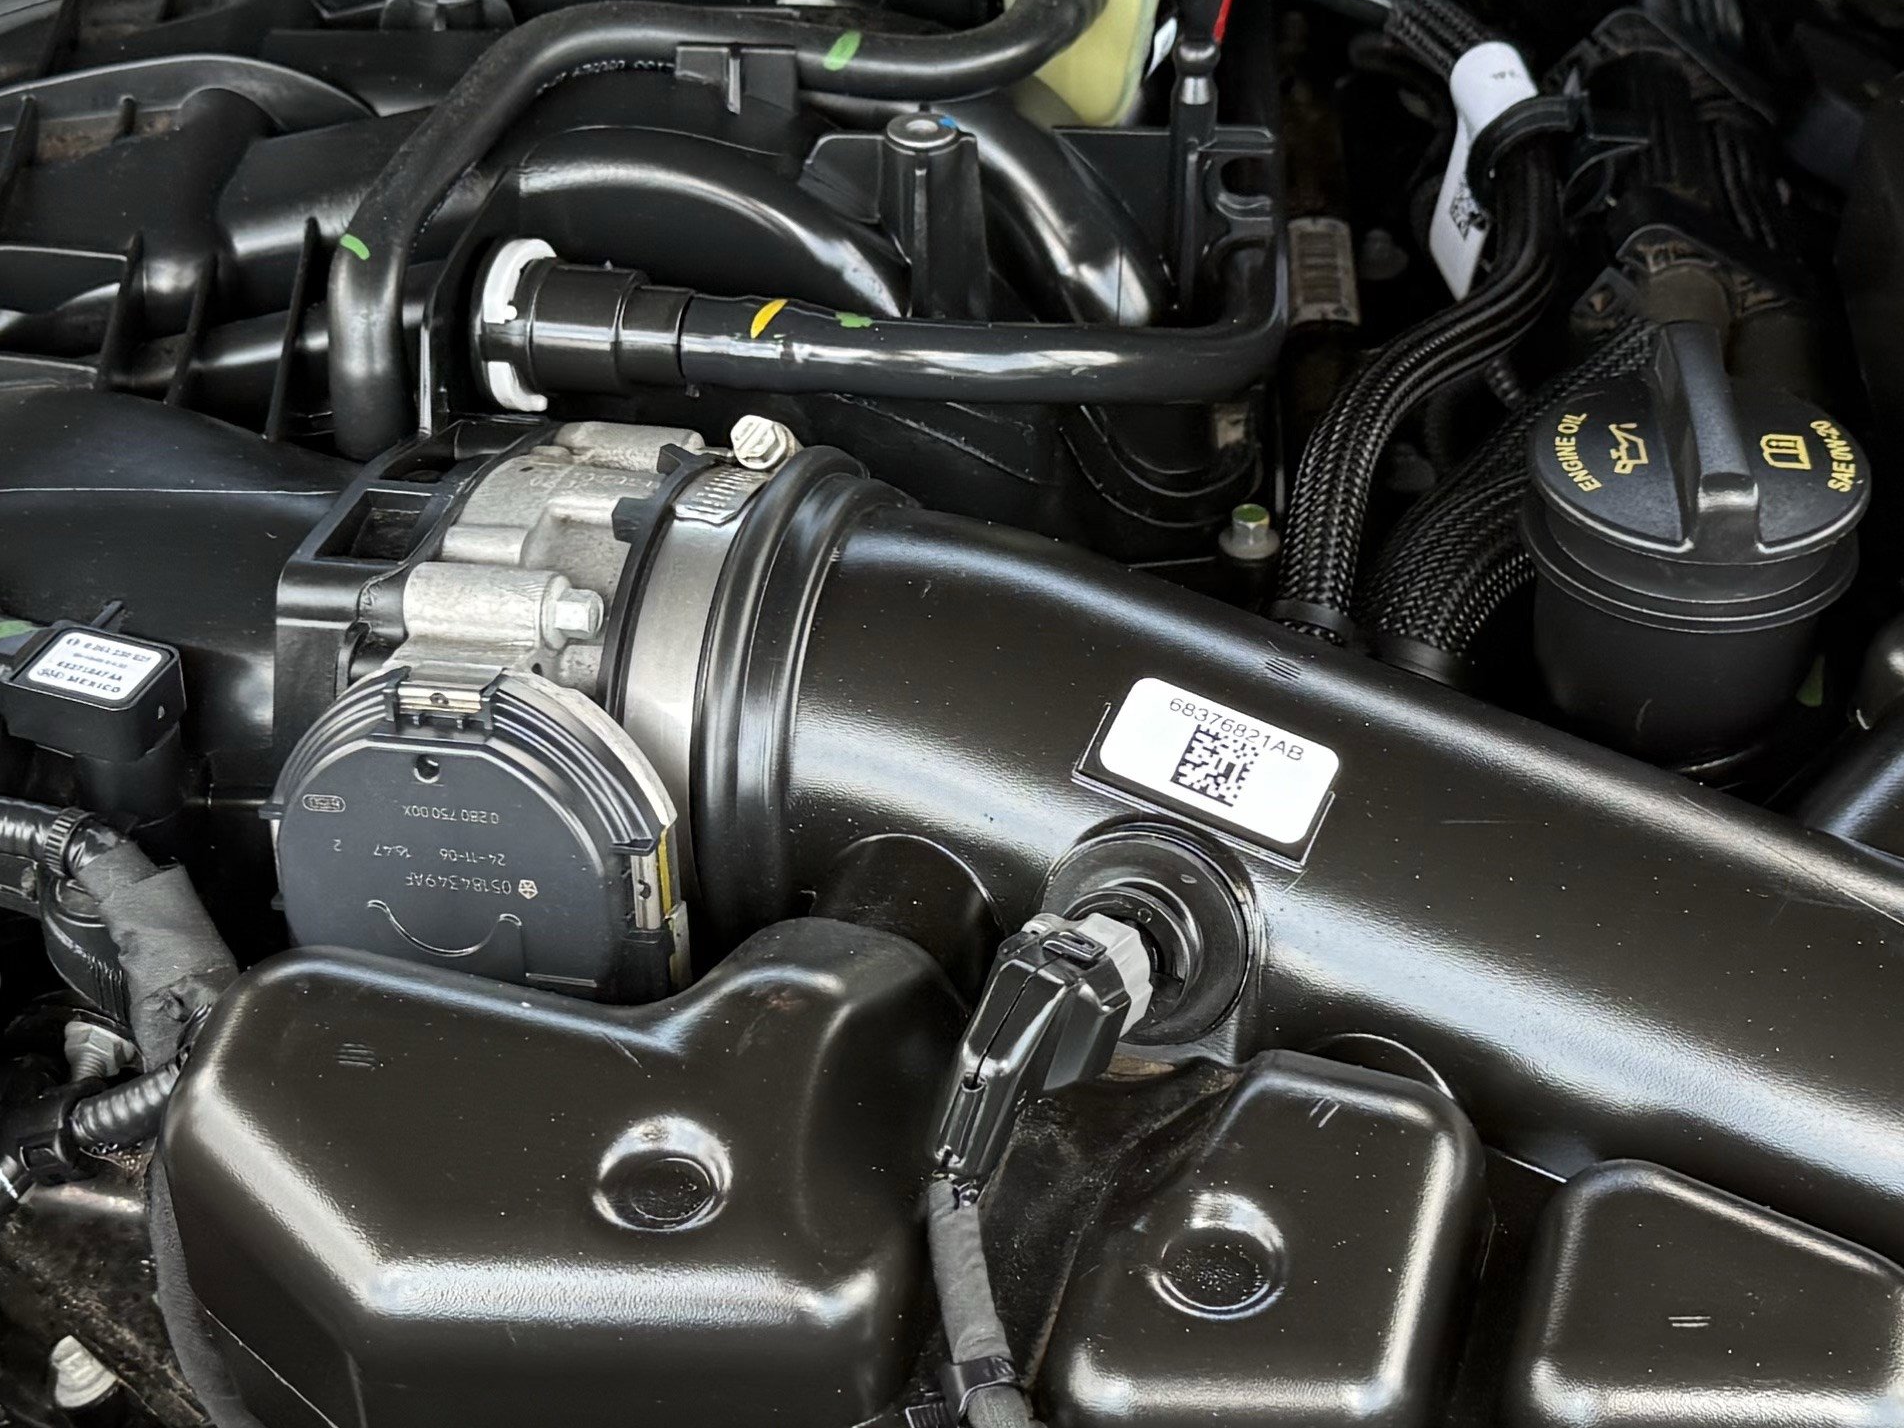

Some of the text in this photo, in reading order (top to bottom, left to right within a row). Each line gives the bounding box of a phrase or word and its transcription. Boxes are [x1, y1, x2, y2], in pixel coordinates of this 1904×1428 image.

[1554, 412, 1602, 492] ENGINE OIL
[1809, 419, 1856, 493] SAE 0W-20
[67, 675, 122, 694] MEXICO
[1168, 697, 1305, 761] 68376821AB
[439, 847, 506, 866] 24-11-06
[406, 872, 512, 894] 05184349AF
